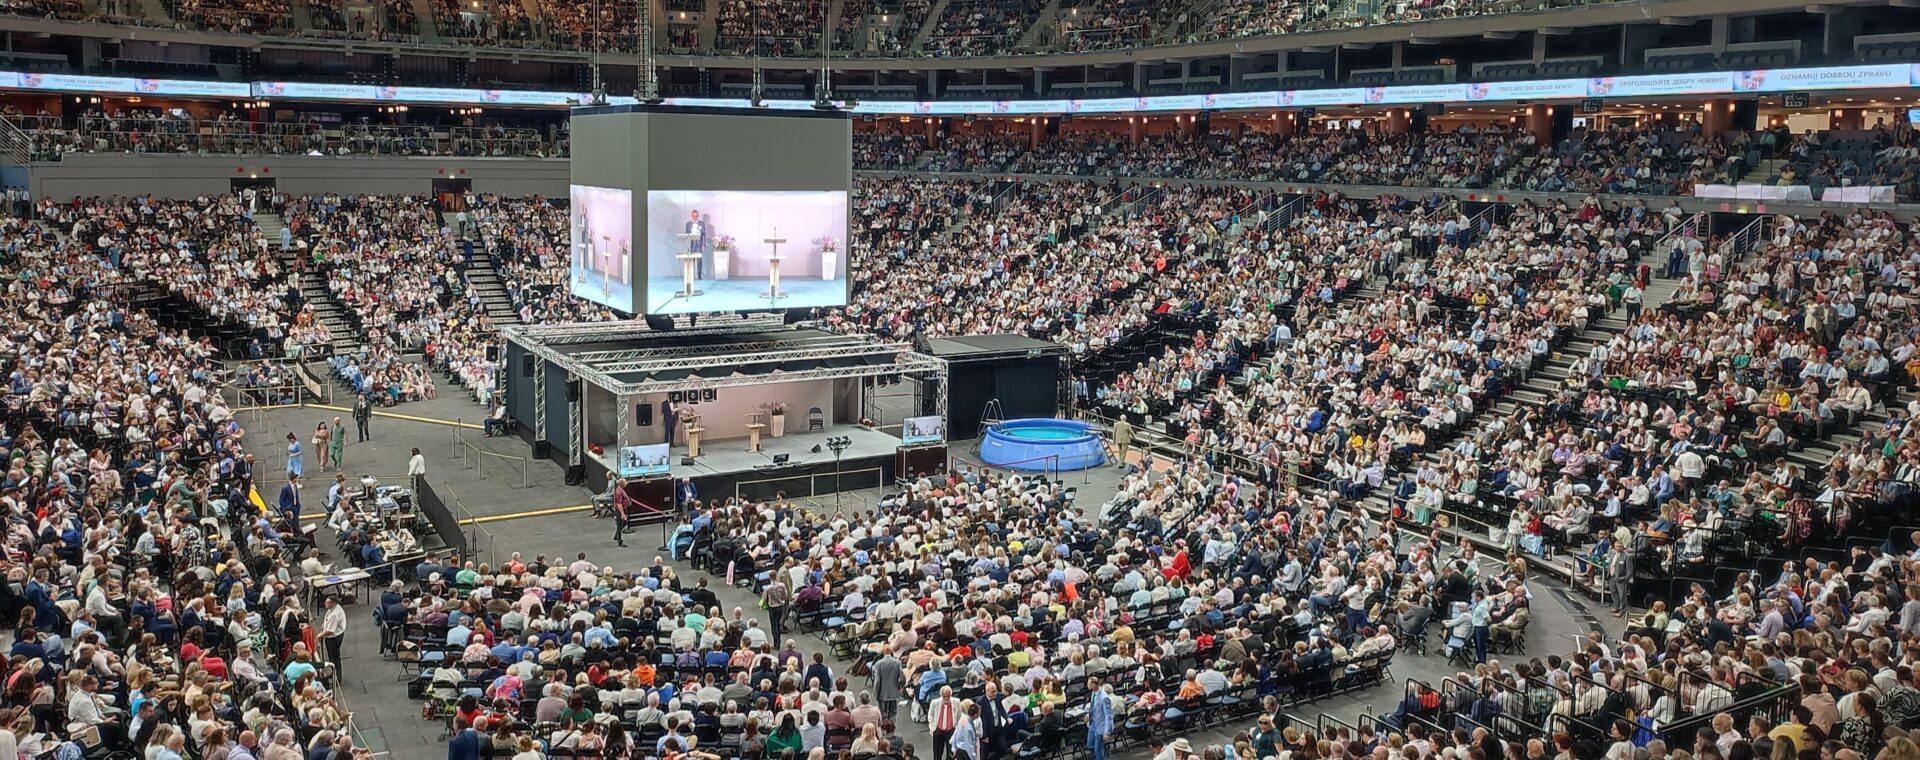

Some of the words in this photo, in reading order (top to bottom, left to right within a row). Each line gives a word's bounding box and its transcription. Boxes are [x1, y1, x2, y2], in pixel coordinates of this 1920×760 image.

[1672, 78, 1695, 86] ДОБРУ
[1696, 76, 1728, 84] НОВИНУ!
[1780, 73, 1818, 81] OZNAMUJ
[1820, 71, 1856, 79] DOBROU
